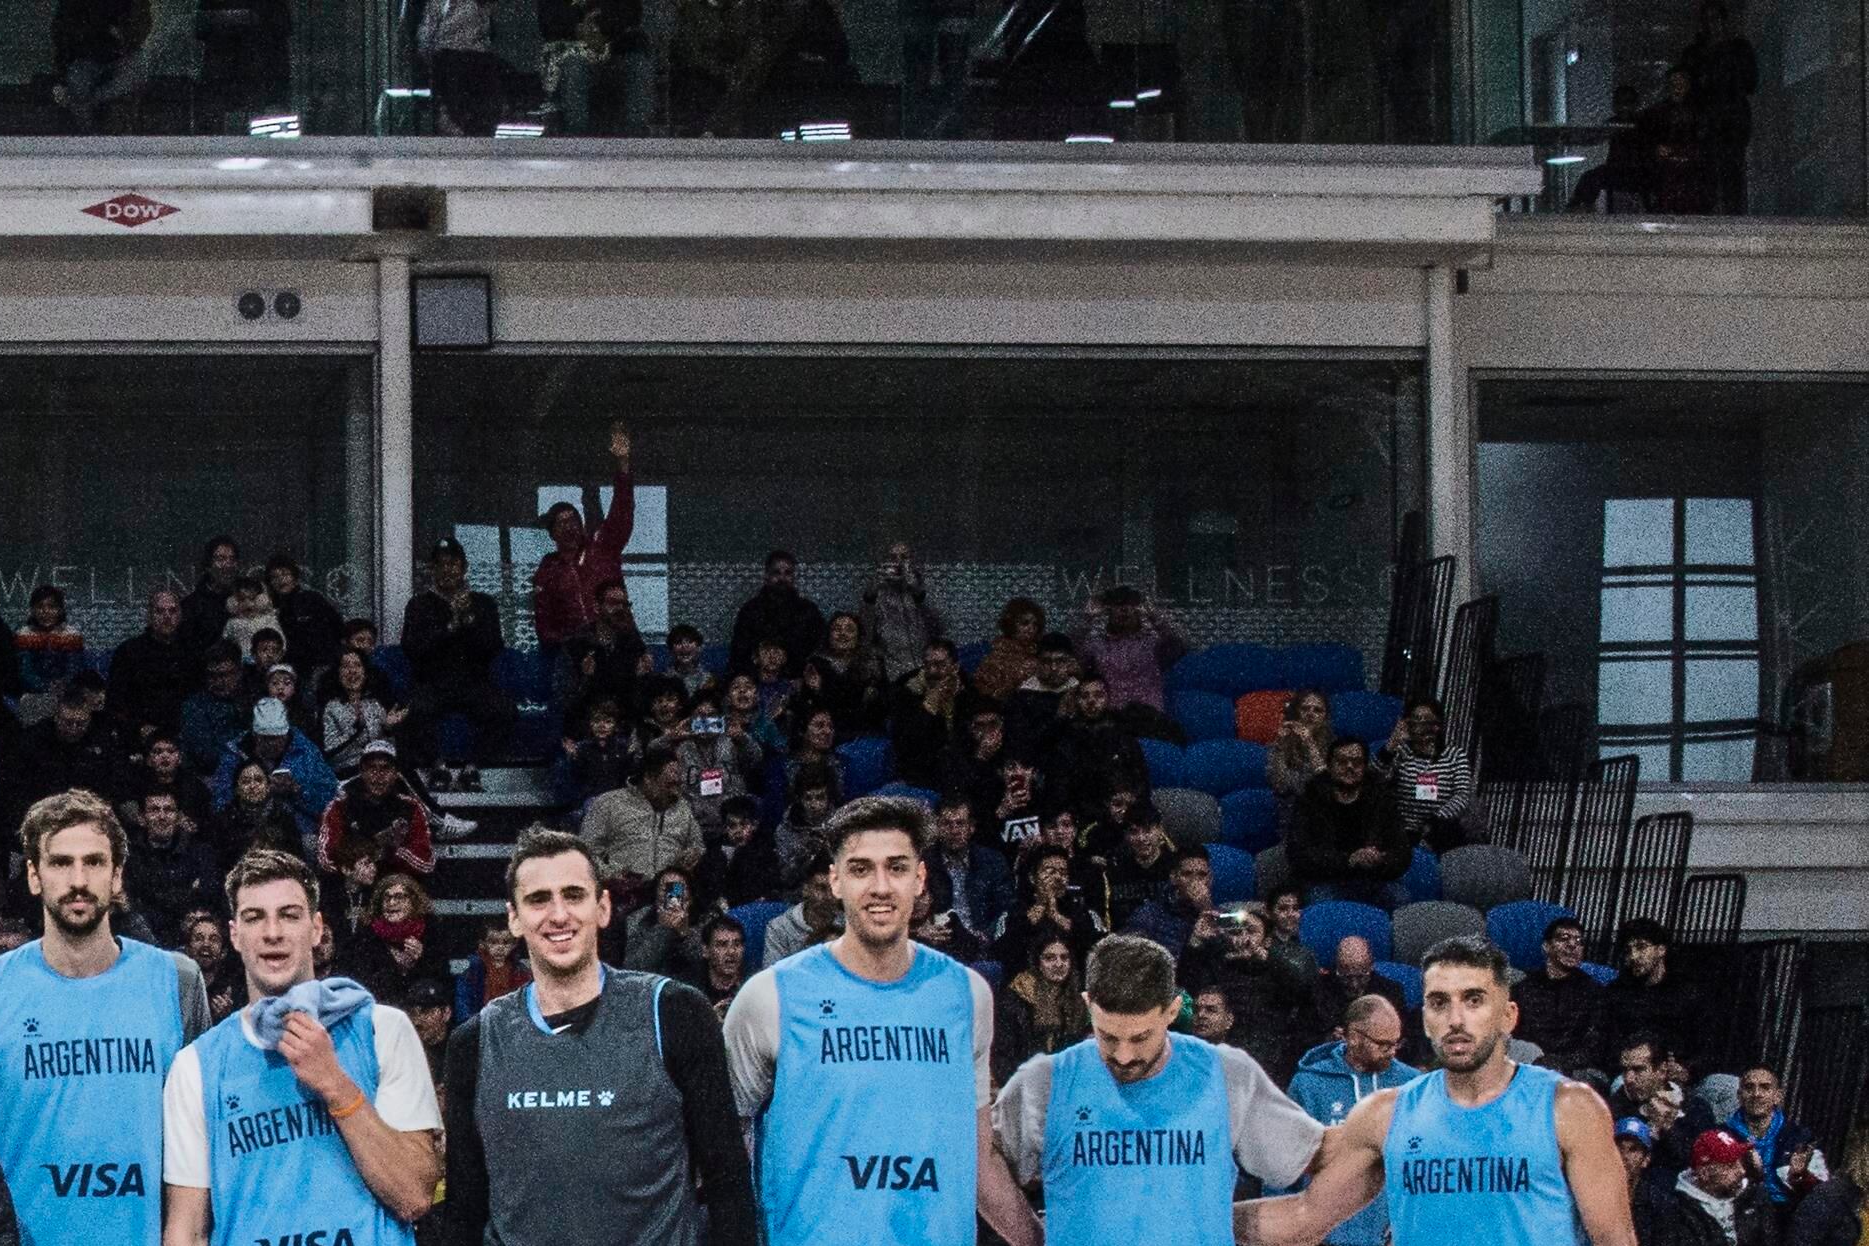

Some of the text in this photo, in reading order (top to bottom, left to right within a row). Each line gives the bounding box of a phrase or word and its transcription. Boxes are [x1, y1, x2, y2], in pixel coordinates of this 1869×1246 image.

[104, 202, 164, 221] DOW
[24, 1038, 156, 1080] ARGENTINA
[821, 1026, 950, 1064] ARGENTINA
[507, 1090, 591, 1109] KELME
[228, 1102, 339, 1158] ARGENTIN
[1072, 1128, 1206, 1168] ARGENTINA
[39, 1162, 147, 1198] VISA
[840, 1155, 940, 1192] VISA
[1402, 1155, 1530, 1197] ARGENTINA
